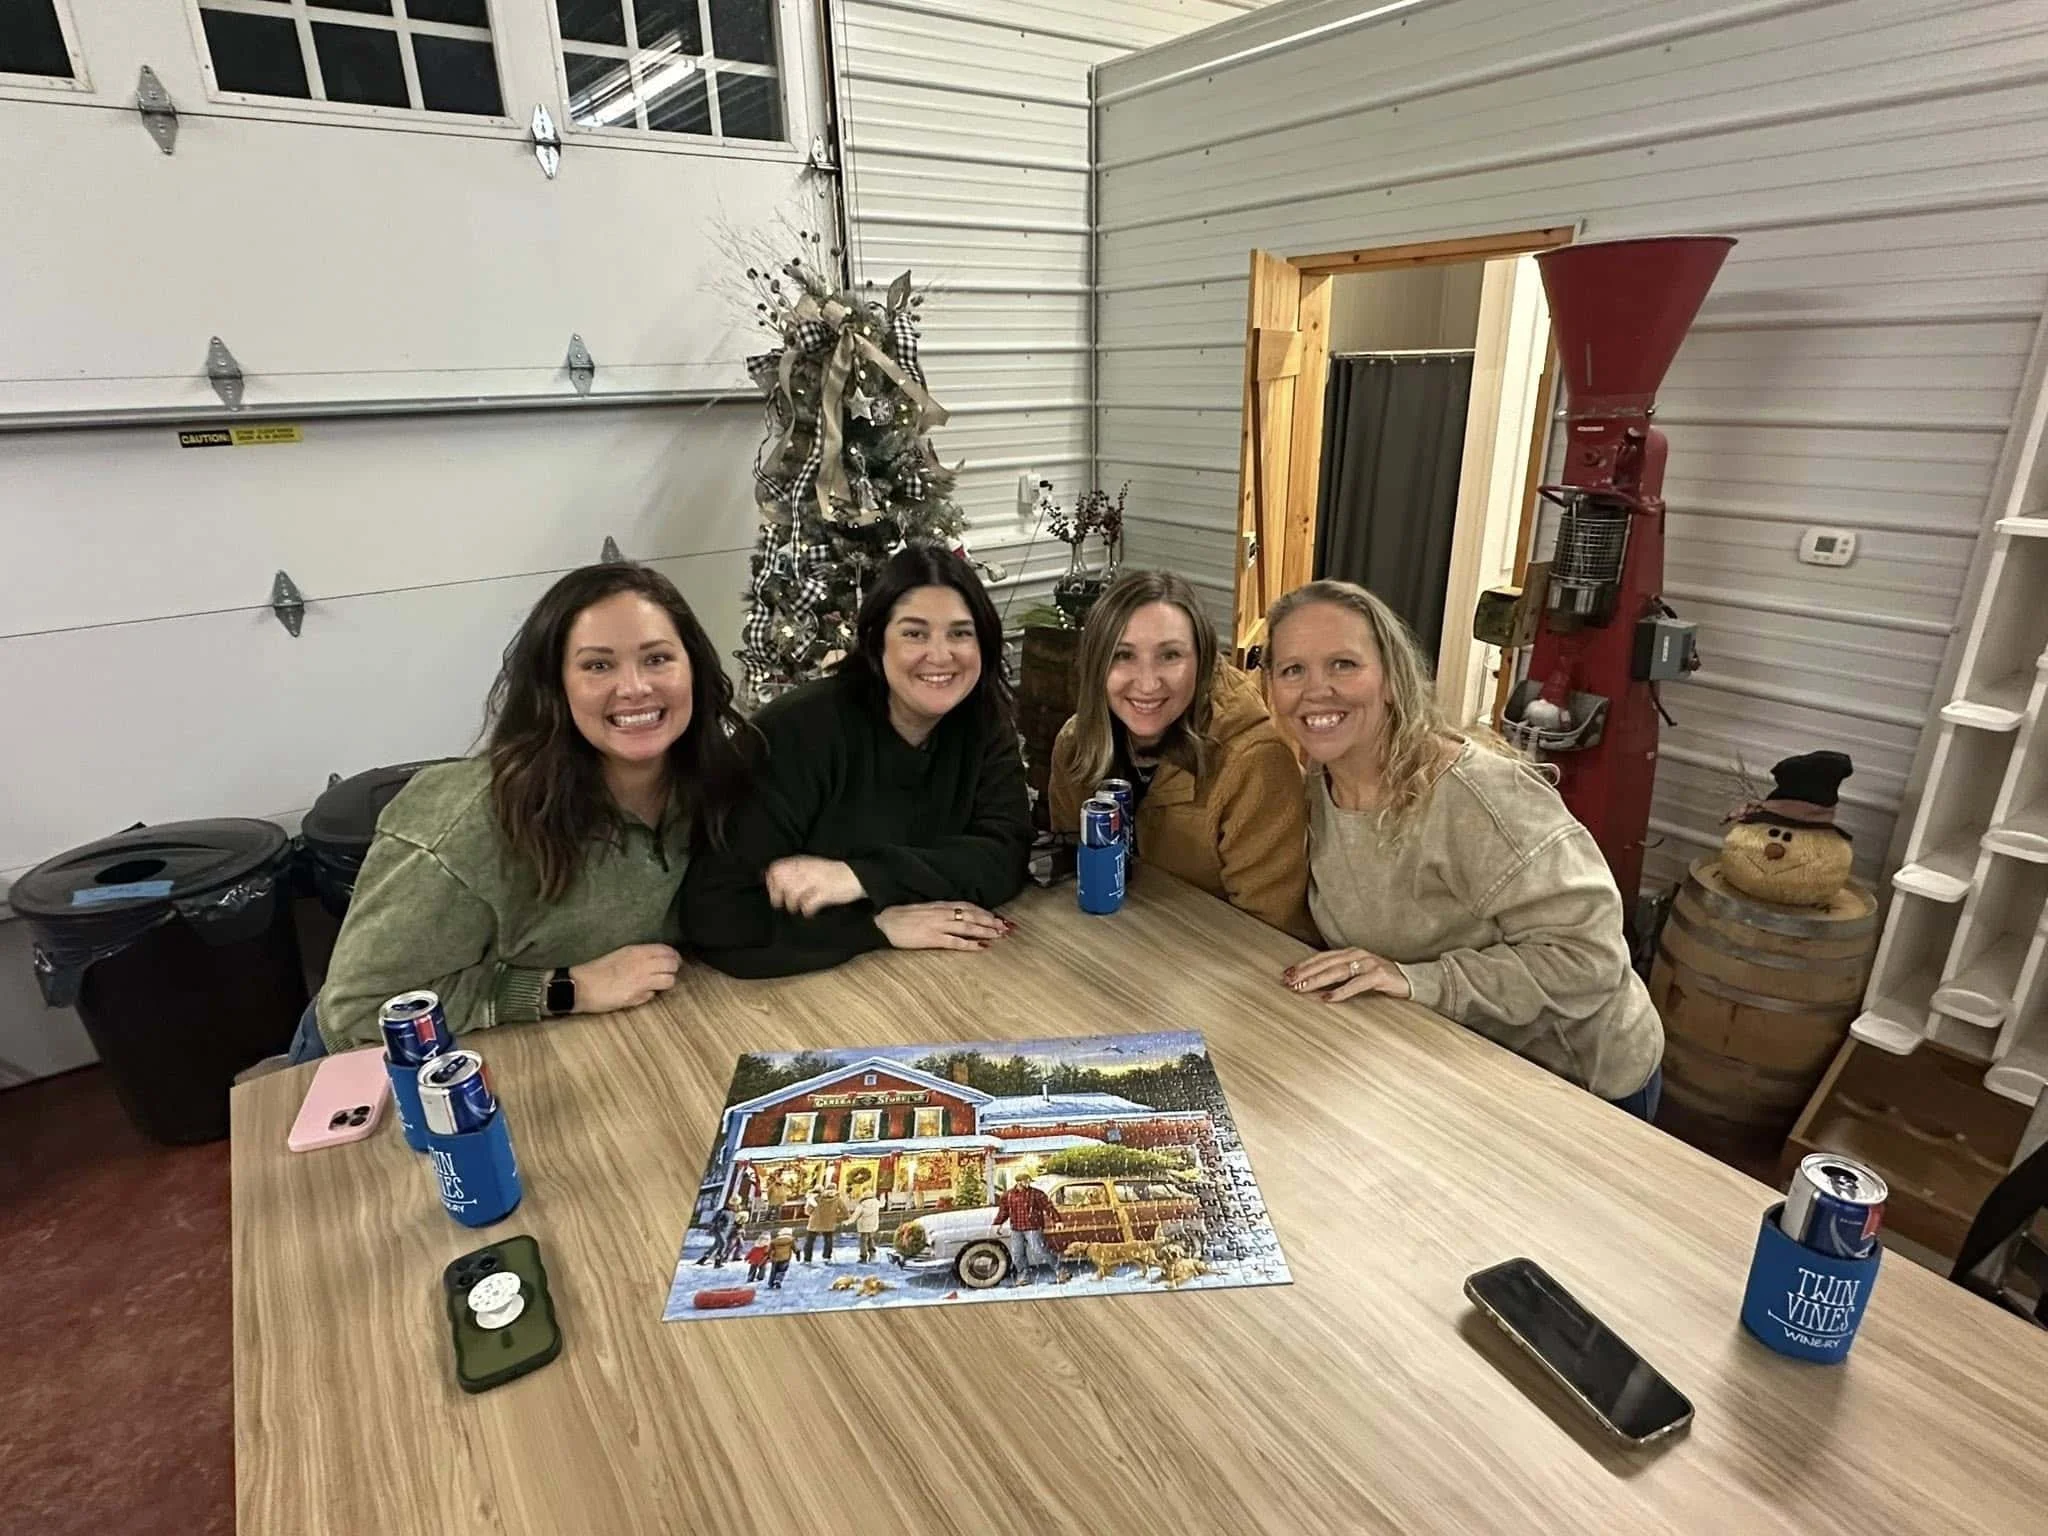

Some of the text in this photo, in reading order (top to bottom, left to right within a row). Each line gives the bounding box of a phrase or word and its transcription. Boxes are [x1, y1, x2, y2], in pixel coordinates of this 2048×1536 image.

[1798, 1267, 1861, 1306] TWIN
[1787, 1291, 1855, 1332] VINES
[1784, 1326, 1840, 1348] WINERY
